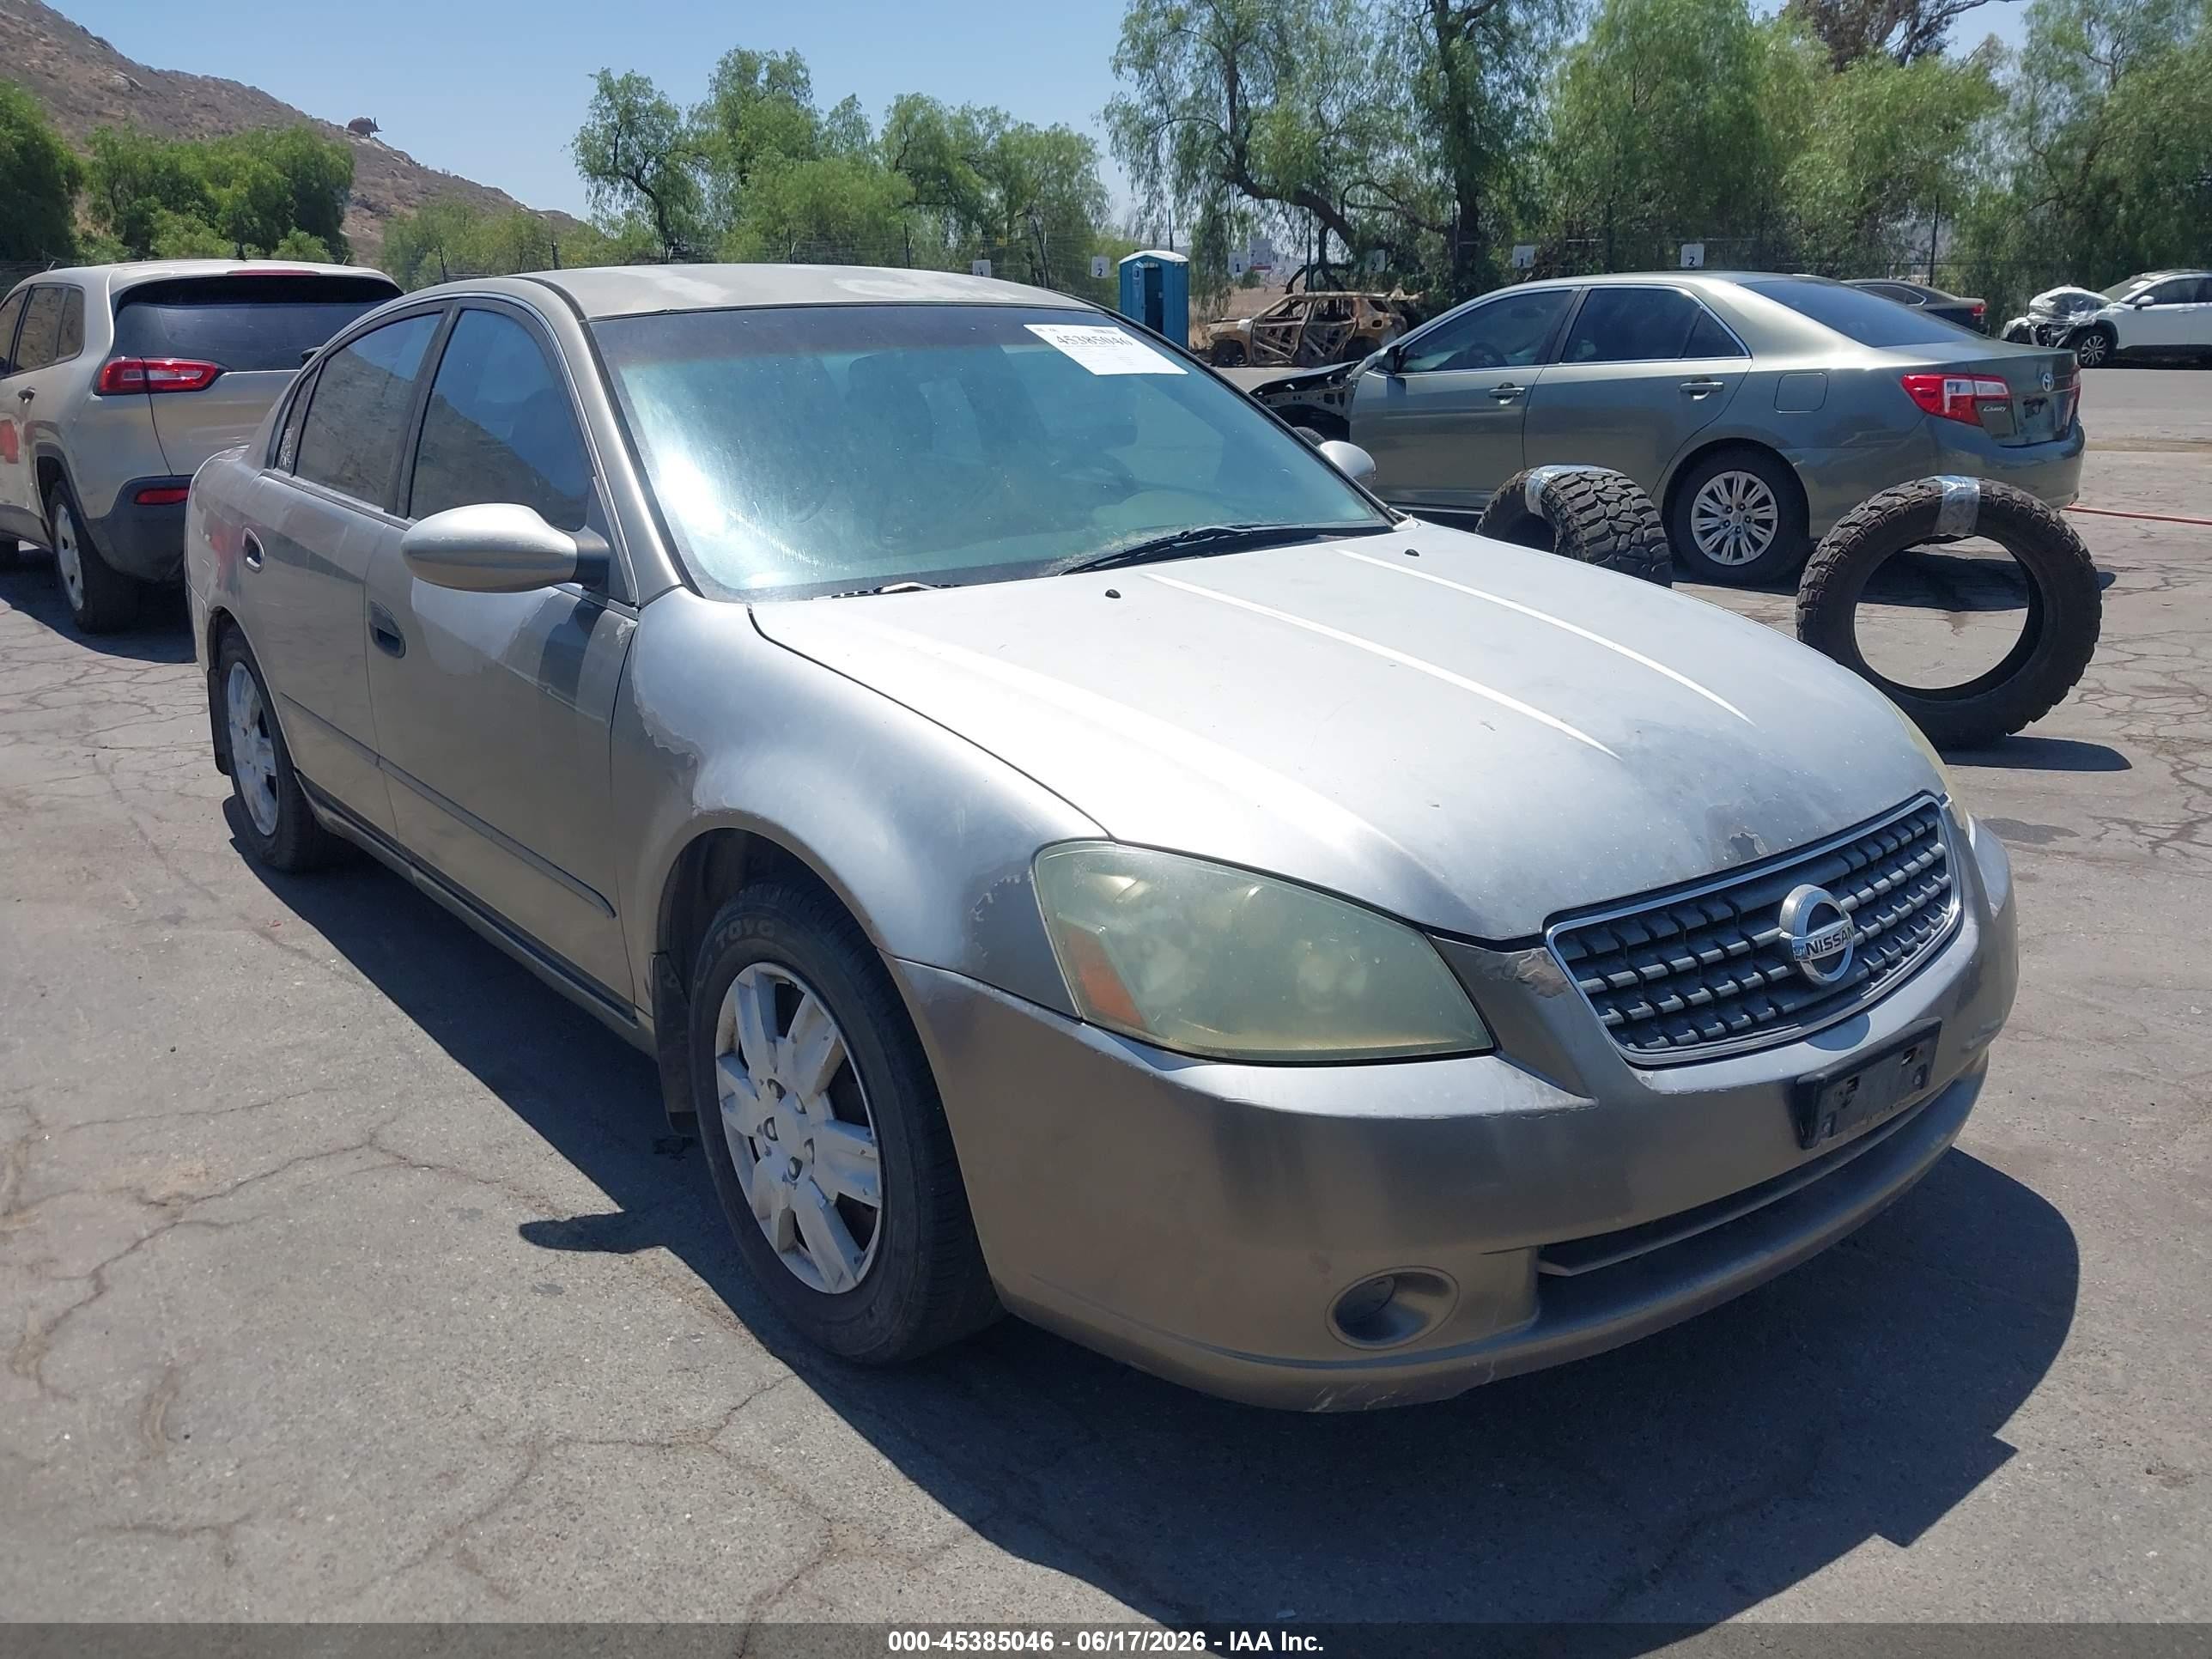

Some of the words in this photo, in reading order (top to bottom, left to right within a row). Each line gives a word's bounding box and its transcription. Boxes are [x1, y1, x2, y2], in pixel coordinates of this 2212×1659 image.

[1519, 258, 1524, 267] 1
[1688, 256, 1695, 266] 2
[1097, 267, 1103, 277] 2
[1236, 263, 1241, 273] 1
[1055, 335, 1133, 346] 45385046
[1805, 927, 1854, 956] NISSAN
